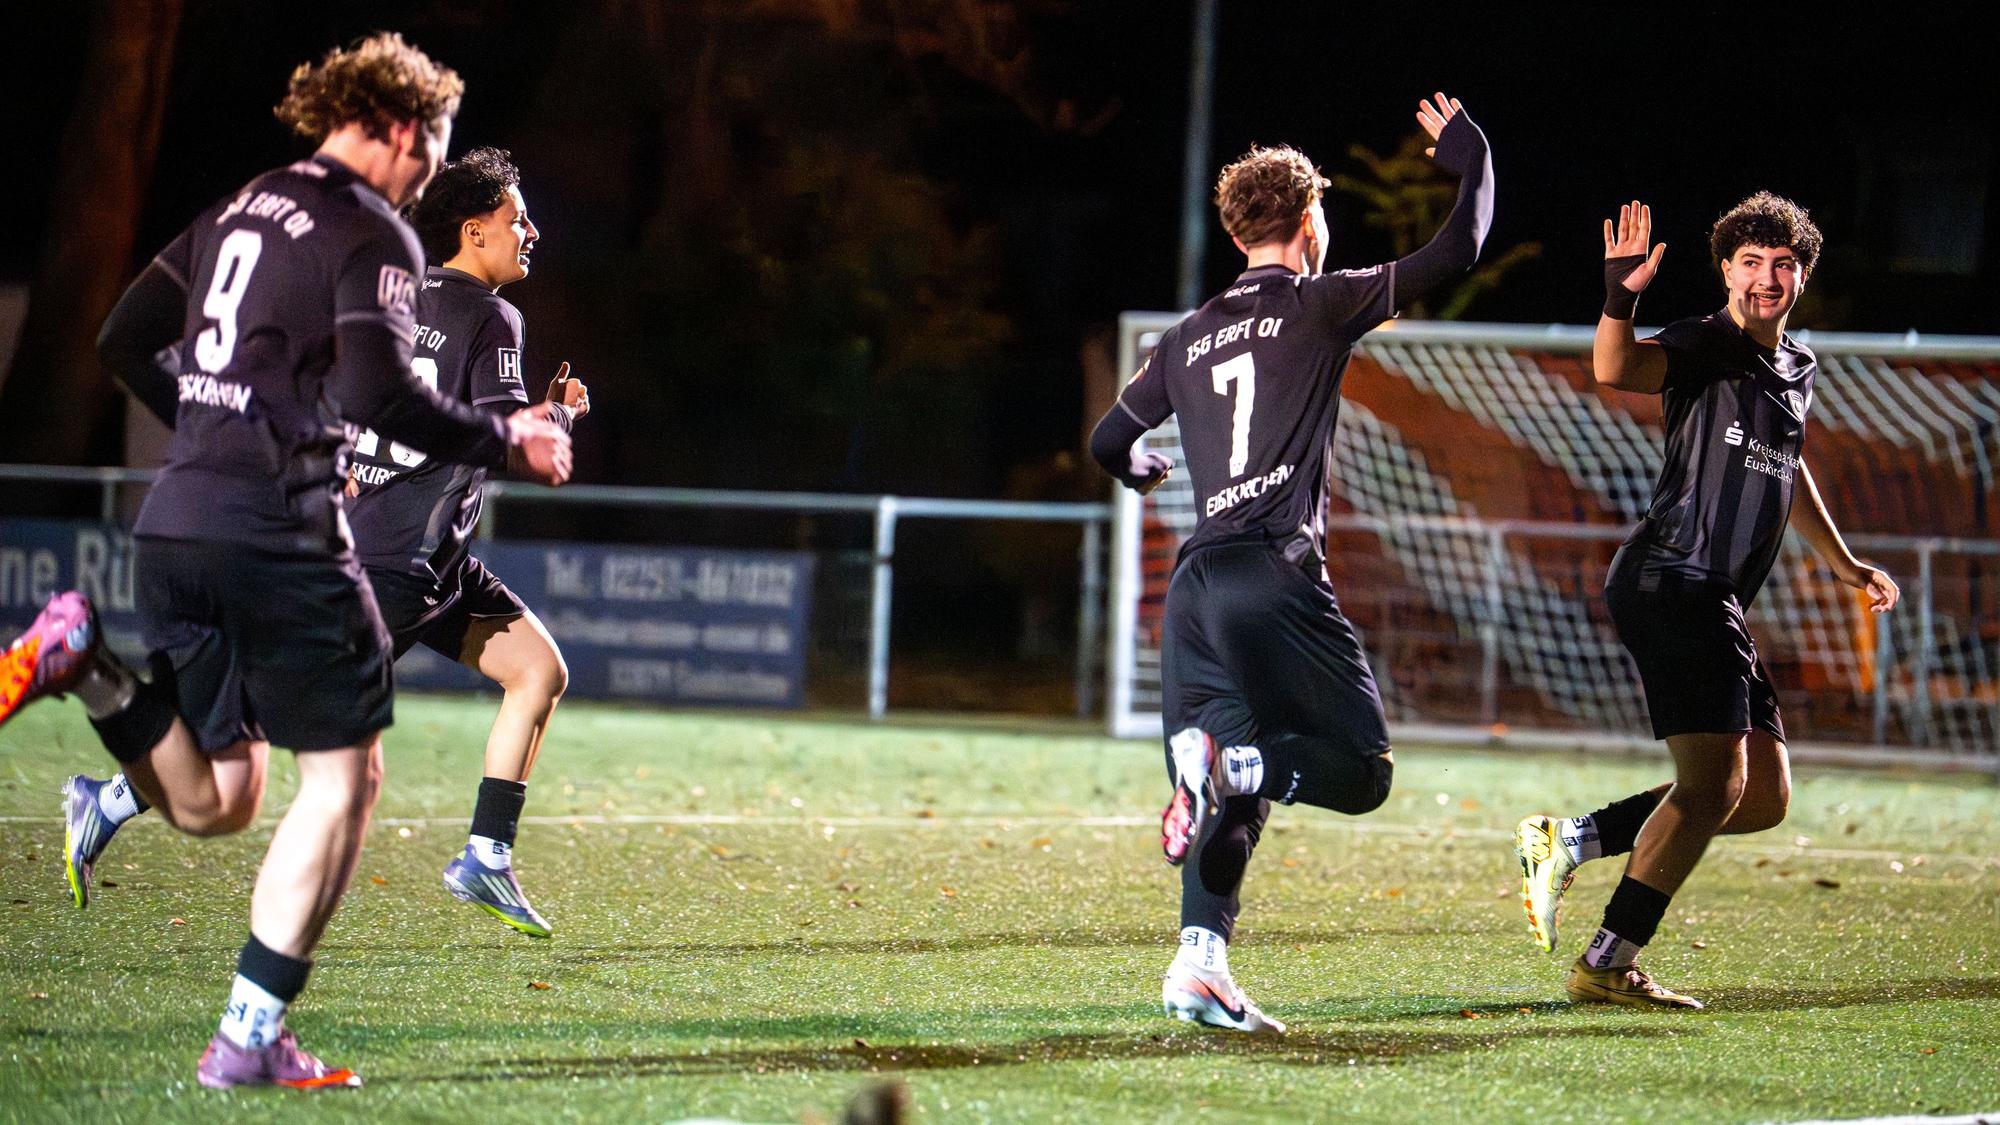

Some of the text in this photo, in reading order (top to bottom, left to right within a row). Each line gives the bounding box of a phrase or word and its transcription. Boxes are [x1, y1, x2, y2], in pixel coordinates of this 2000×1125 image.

[193, 228, 263, 375] 9
[1186, 333, 1212, 367] JSG
[1214, 317, 1255, 350] ERFT
[1211, 351, 1255, 479] 7
